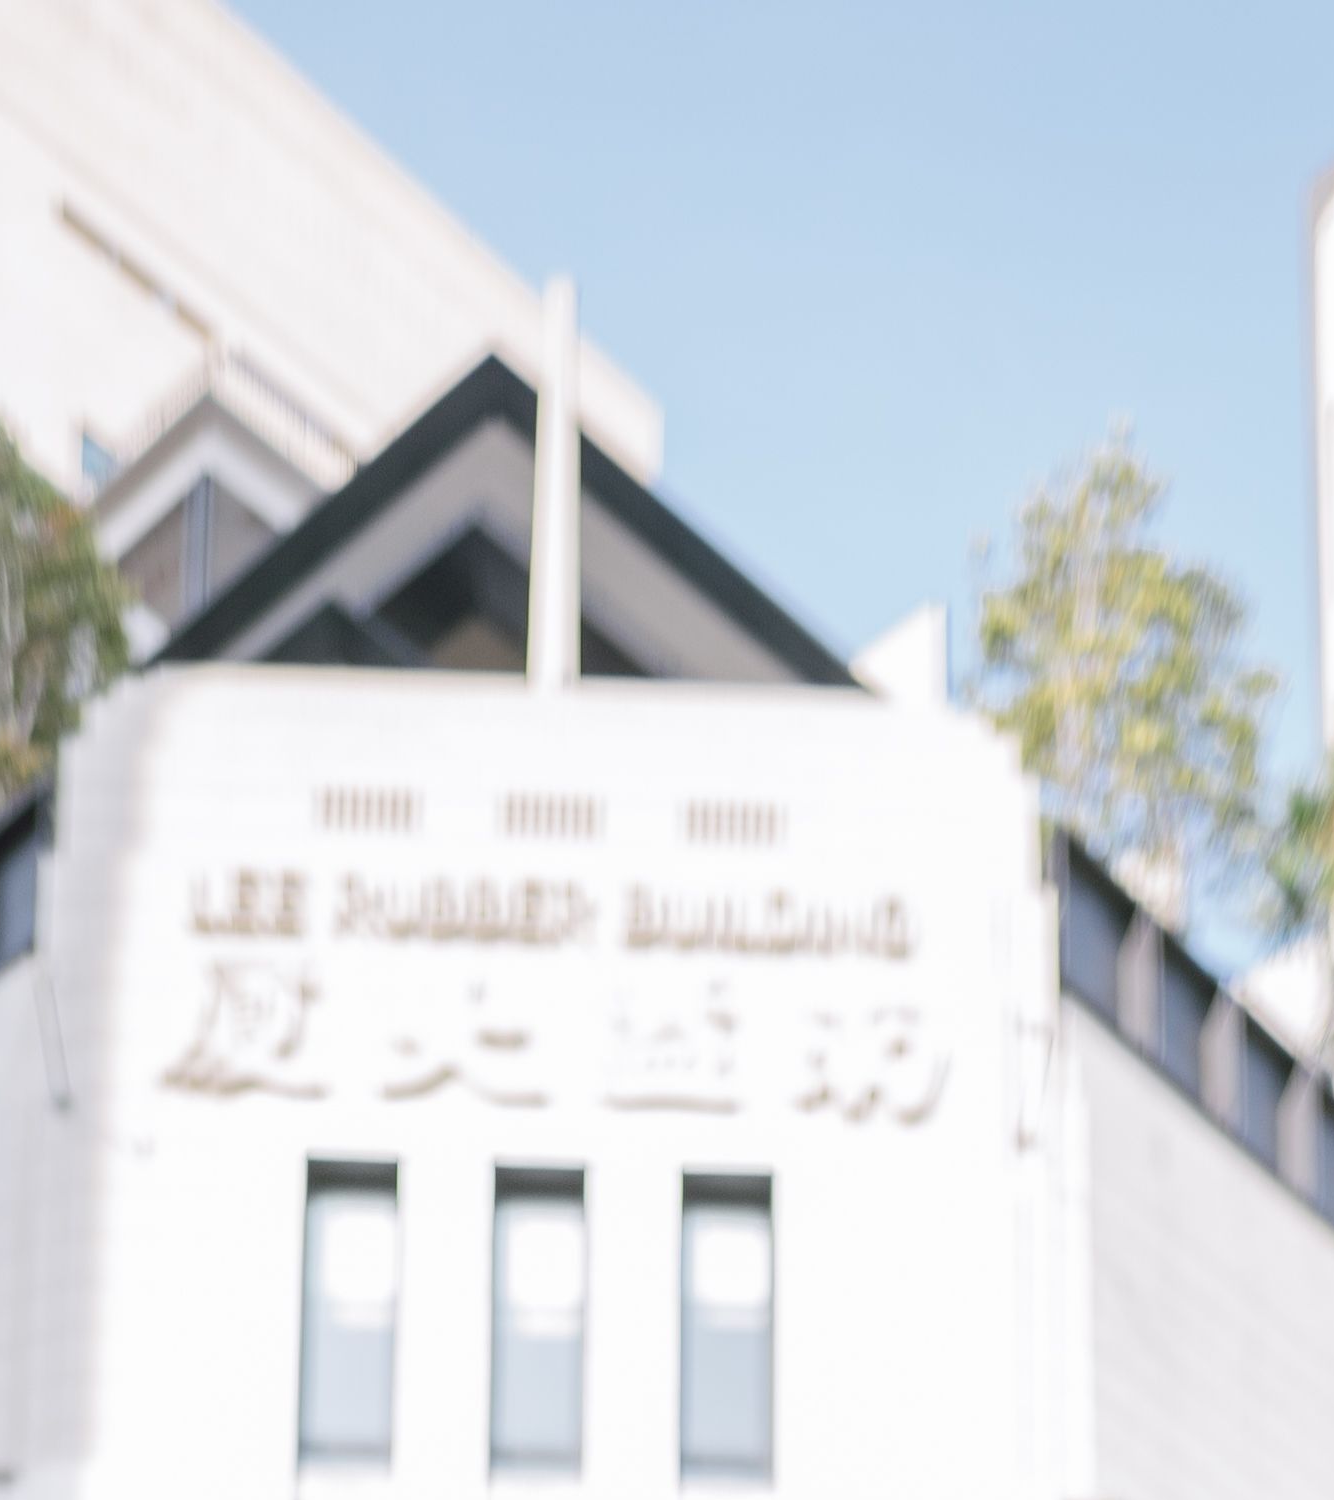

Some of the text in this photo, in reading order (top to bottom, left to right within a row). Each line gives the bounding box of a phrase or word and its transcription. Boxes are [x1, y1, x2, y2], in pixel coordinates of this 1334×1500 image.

[188, 865, 915, 962] LEE RUBBER BUILDING
